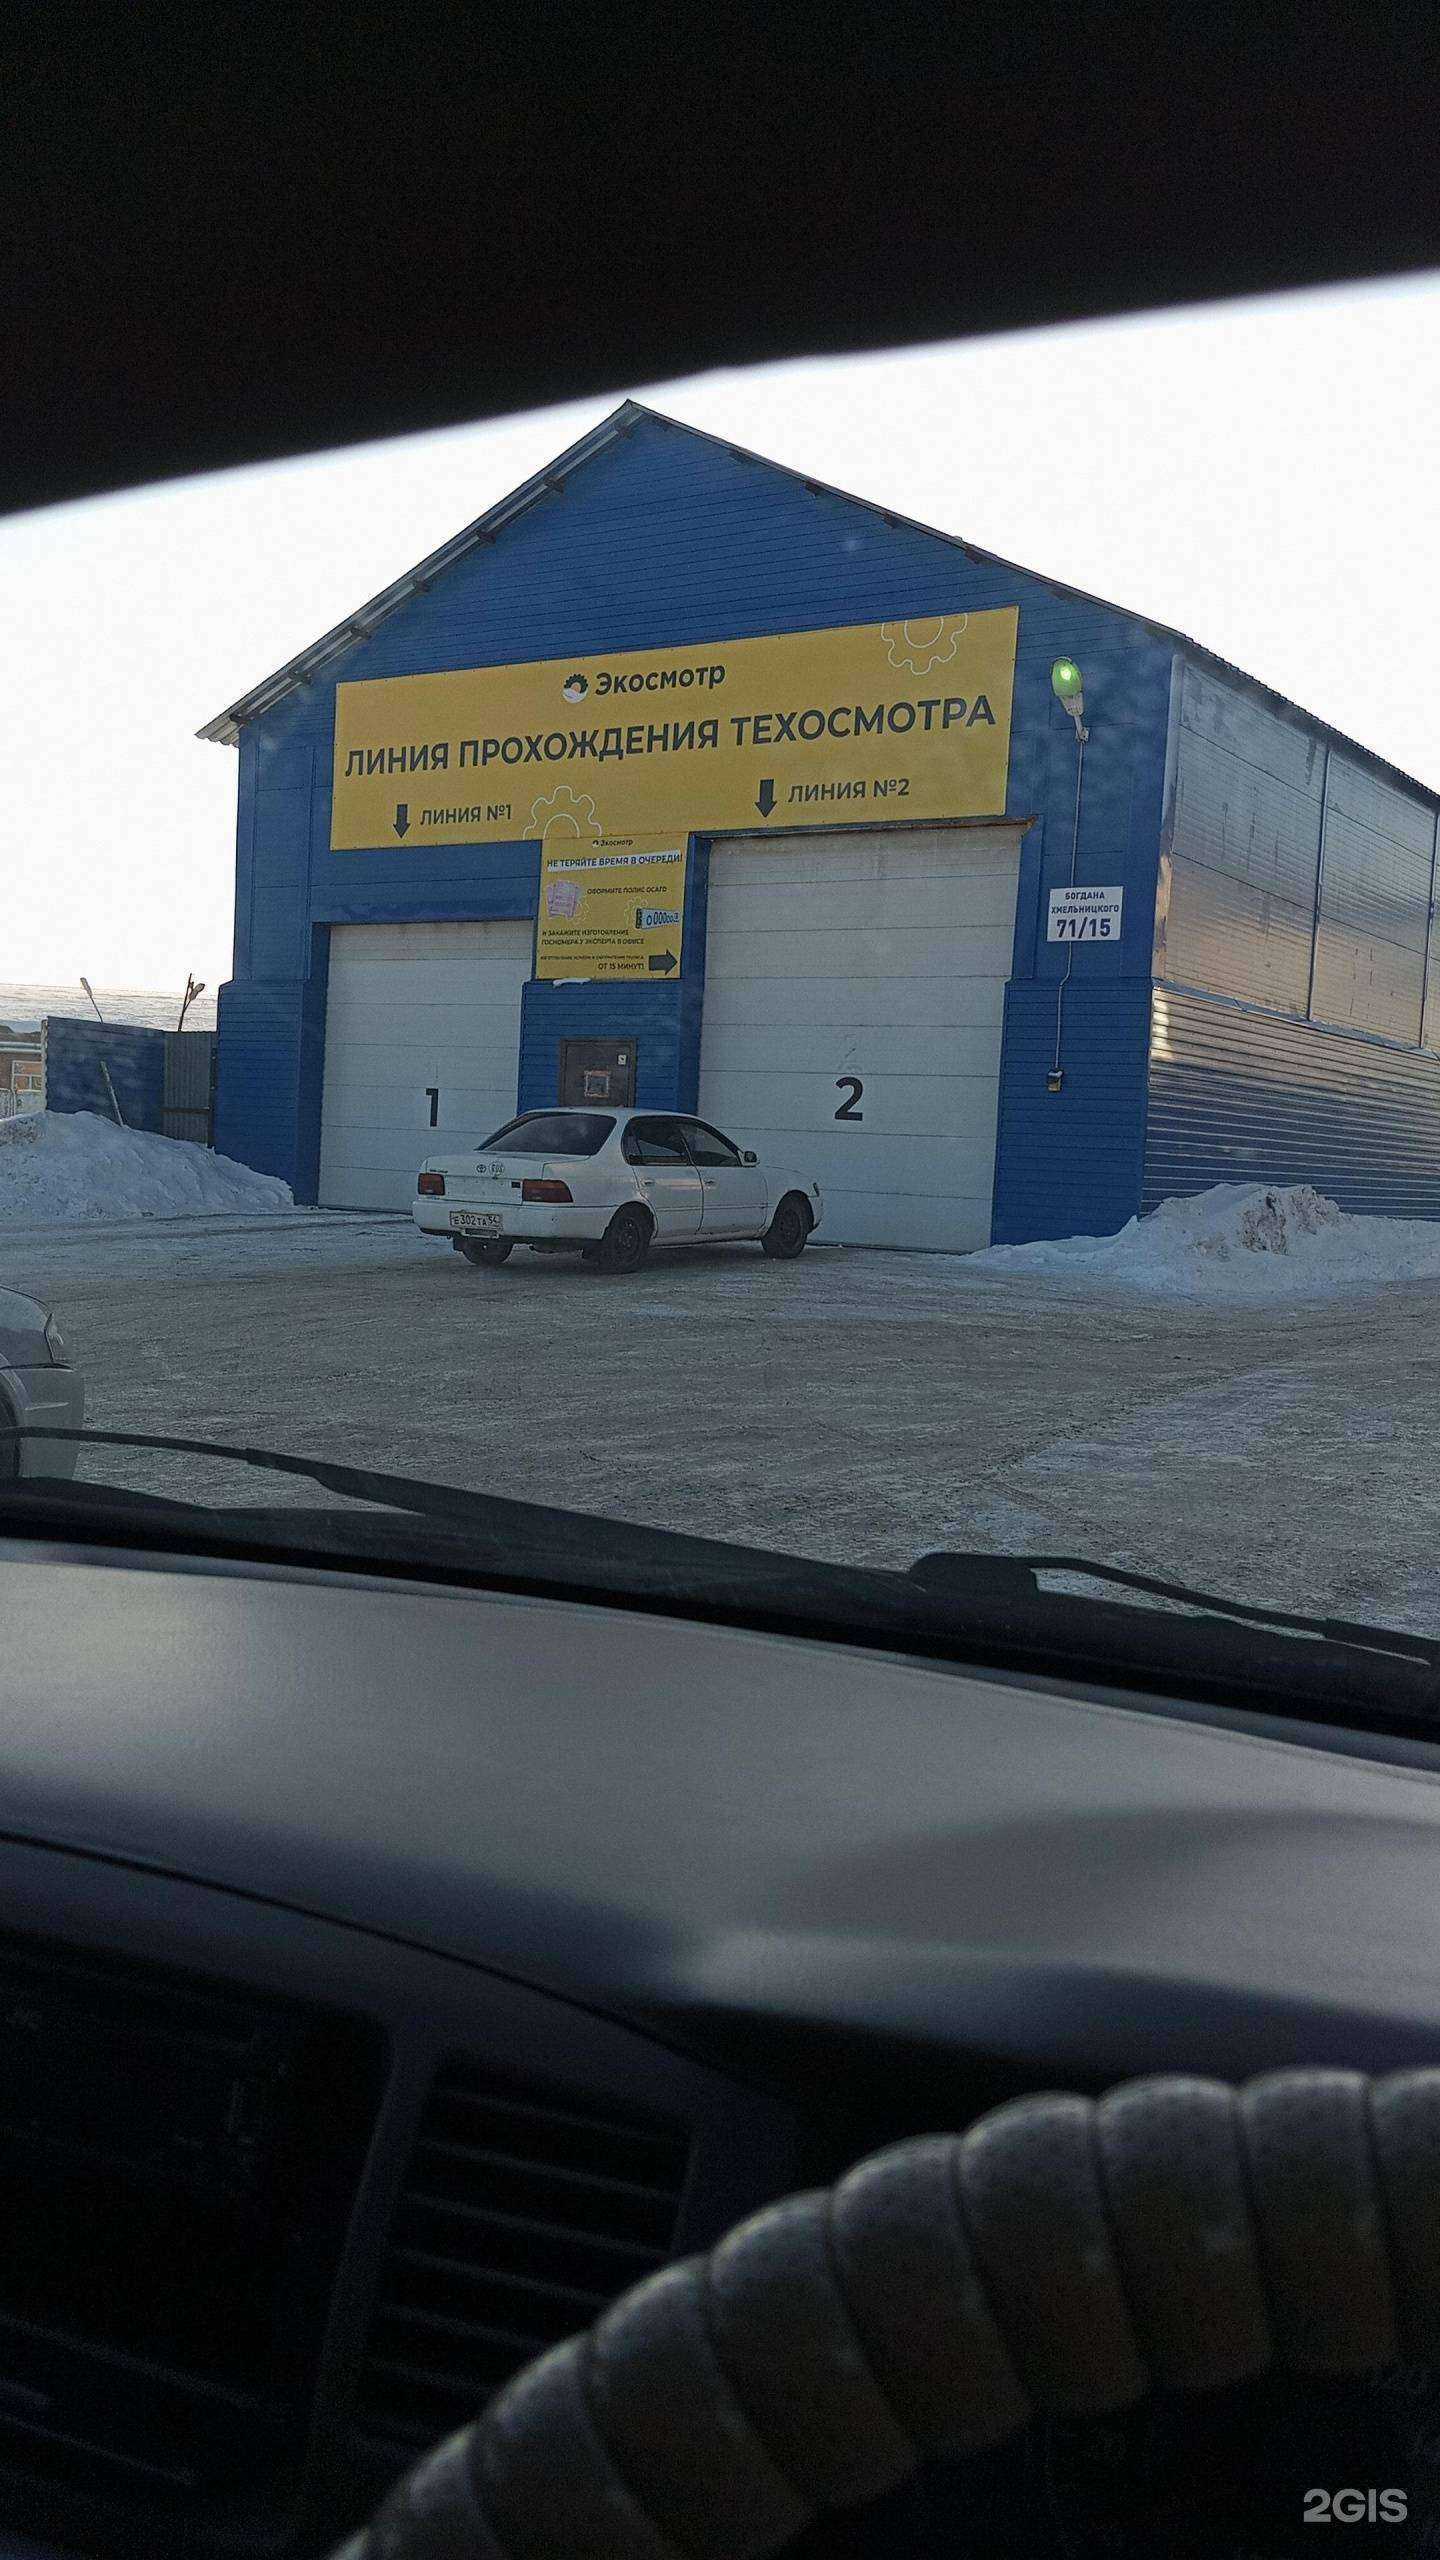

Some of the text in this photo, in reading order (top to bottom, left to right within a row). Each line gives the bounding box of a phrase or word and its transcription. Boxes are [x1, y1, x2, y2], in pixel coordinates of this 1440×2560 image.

[595, 664, 726, 695] Экосмотр
[344, 694, 997, 777] ЛИНИЯ ПРОХОЖДЕНИЯ ТЕХОСМОТРА
[788, 778, 910, 803] ЛИНИЯ №2
[420, 803, 511, 825] ЛИНИЯ №1
[546, 853, 683, 868] НЕ ТЕРЯЙТЕ ВРЕМЯ В ОЧЕРЕДИ!
[1065, 891, 1105, 900] БОГДАНА
[1051, 904, 1120, 914] ХМЕЛЬНИЦКОГО
[1056, 916, 1111, 939] 71/15
[598, 962, 608, 970] ОТ
[425, 1087, 439, 1127] 1
[834, 1076, 863, 1121] 2
